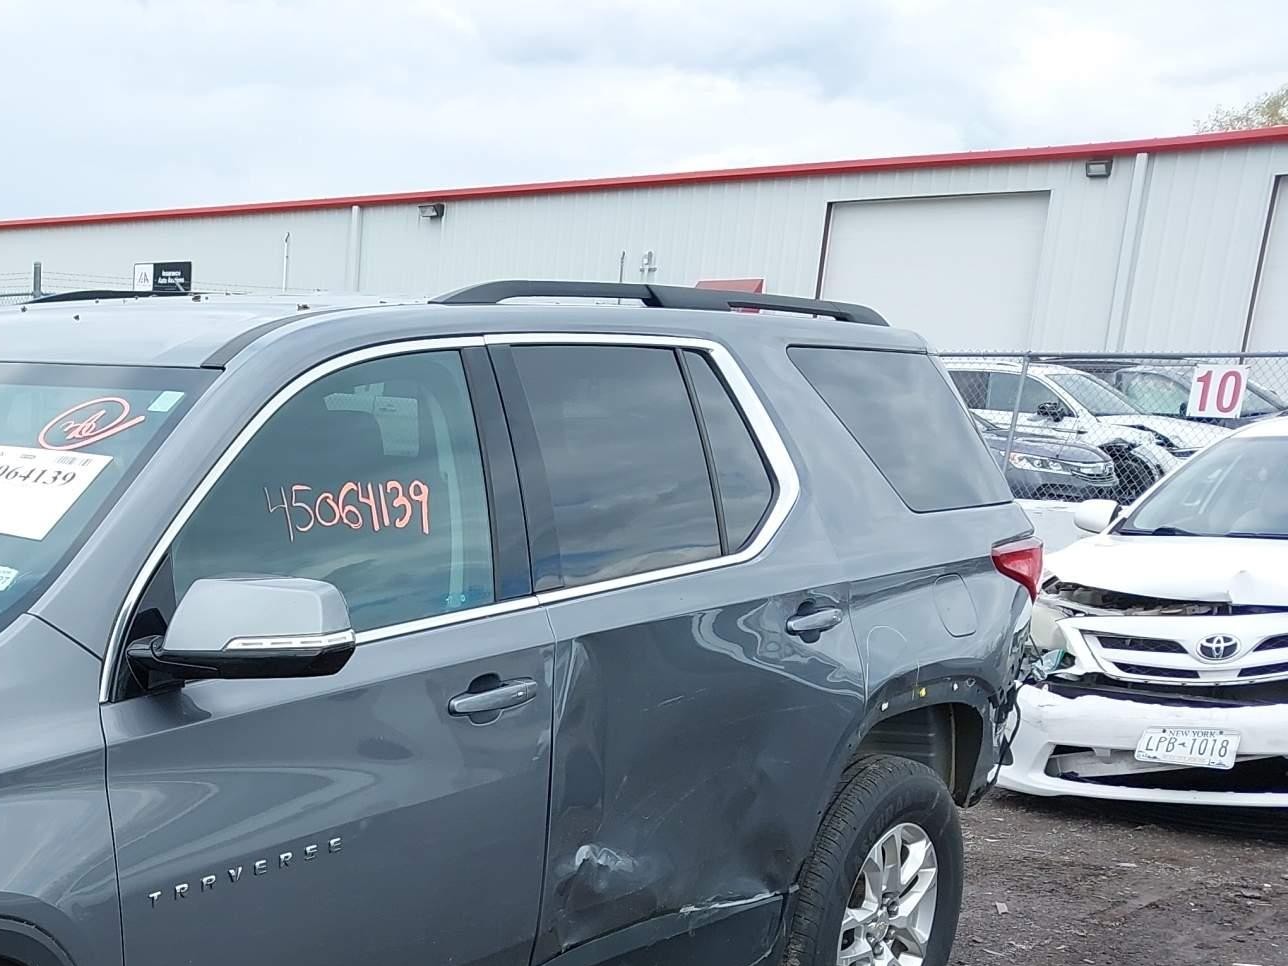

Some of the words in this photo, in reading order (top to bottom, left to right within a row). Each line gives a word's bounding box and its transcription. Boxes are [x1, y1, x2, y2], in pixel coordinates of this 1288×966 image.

[1196, 370, 1242, 413] 10
[264, 480, 429, 542] 45064139
[1169, 729, 1190, 737] NEW
[1191, 730, 1216, 738] YORK
[148, 837, 342, 908] TRAVERSE
